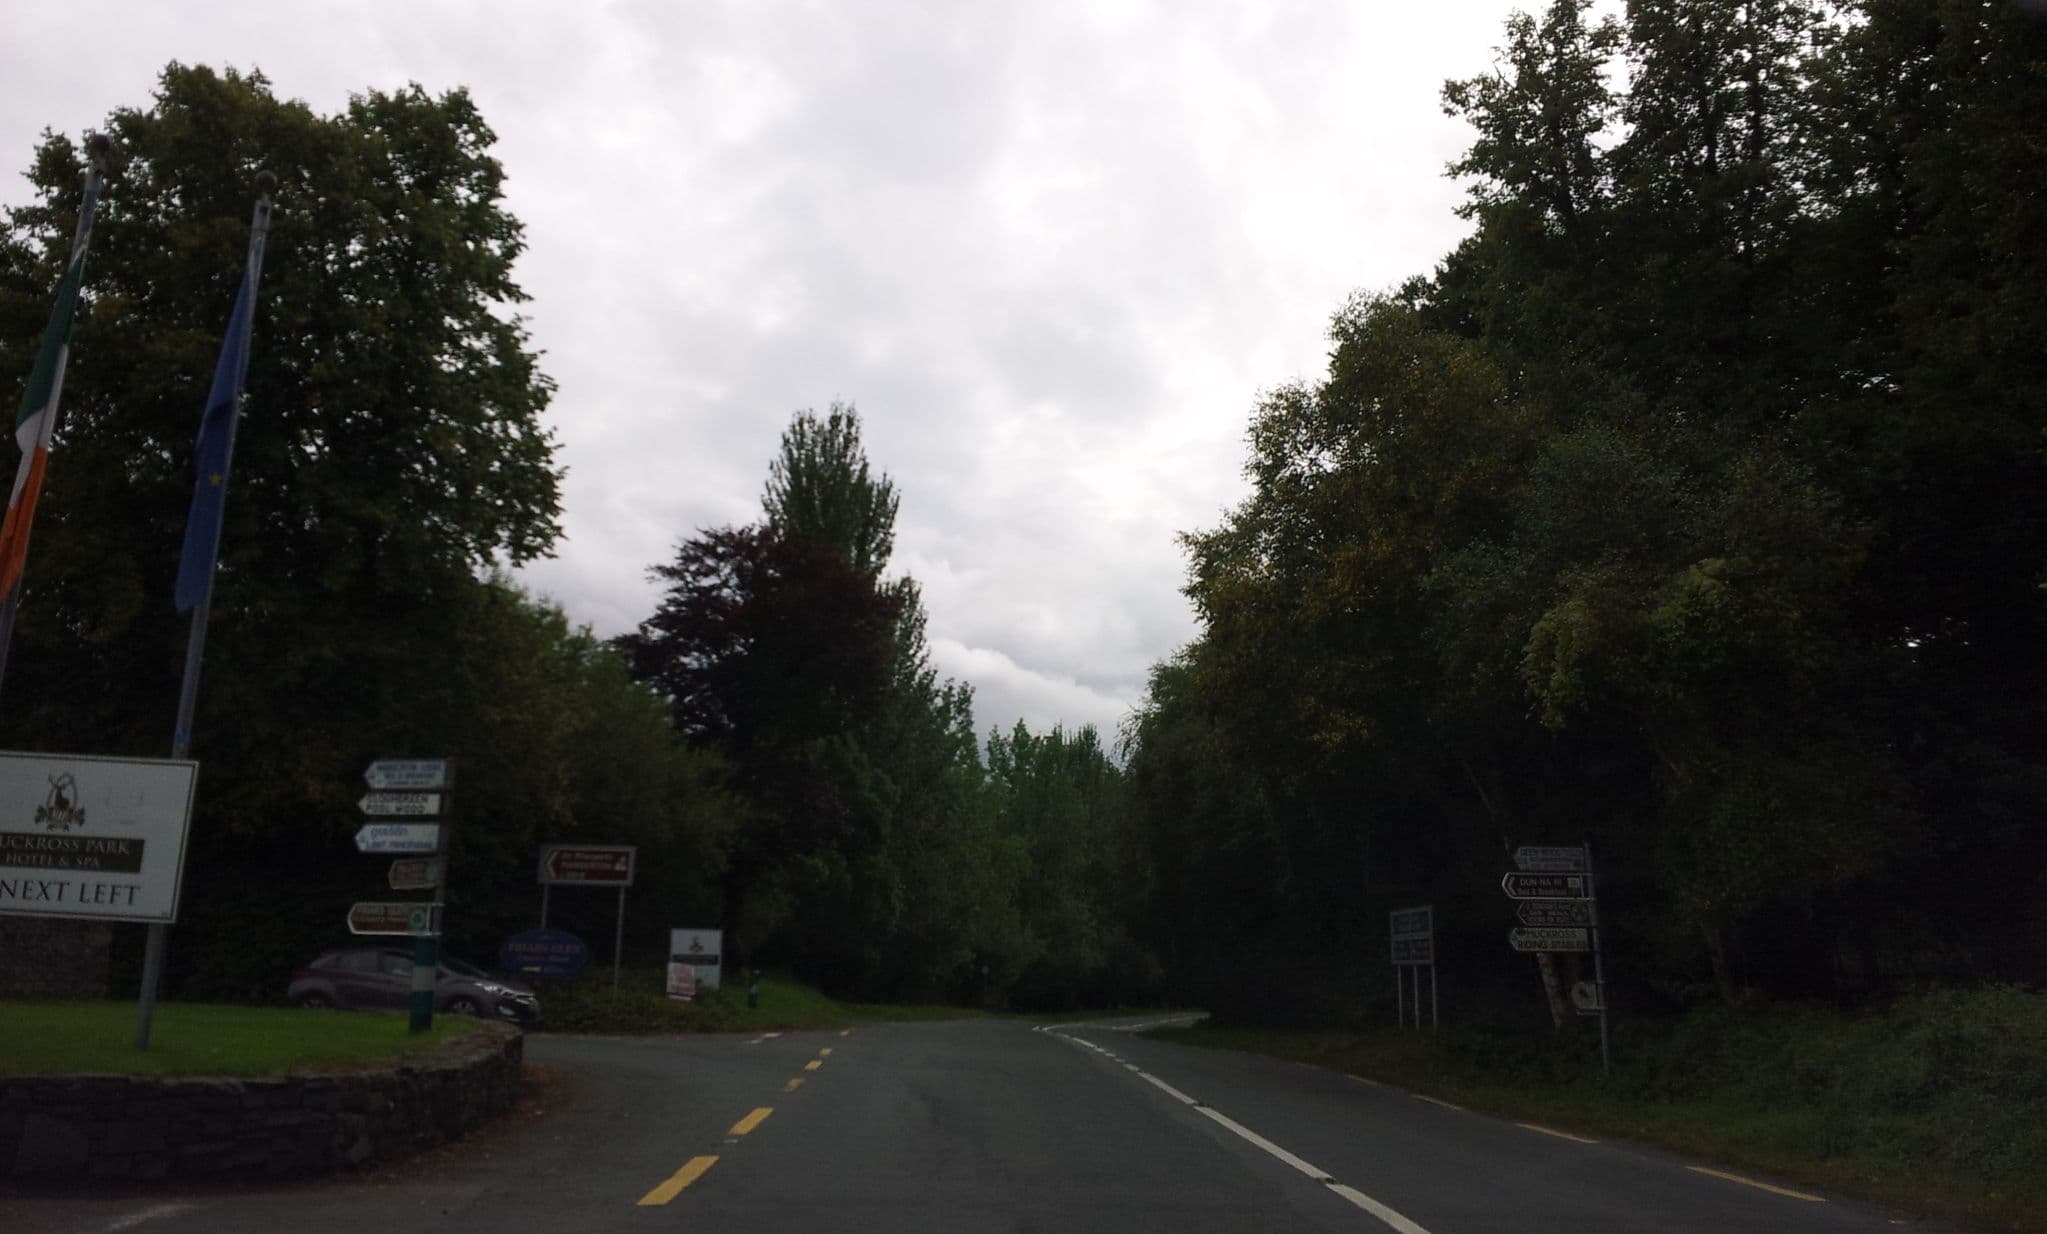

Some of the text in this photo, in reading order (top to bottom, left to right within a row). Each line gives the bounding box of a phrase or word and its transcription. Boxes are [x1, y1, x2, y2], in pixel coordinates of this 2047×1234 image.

[0, 835, 130, 855] UCKROSS PARK
[6, 852, 54, 866] HOTEL
[76, 855, 100, 866] SPA
[0, 879, 142, 905] NEXT LEFT
[1526, 929, 1577, 939] MUCKROSS
